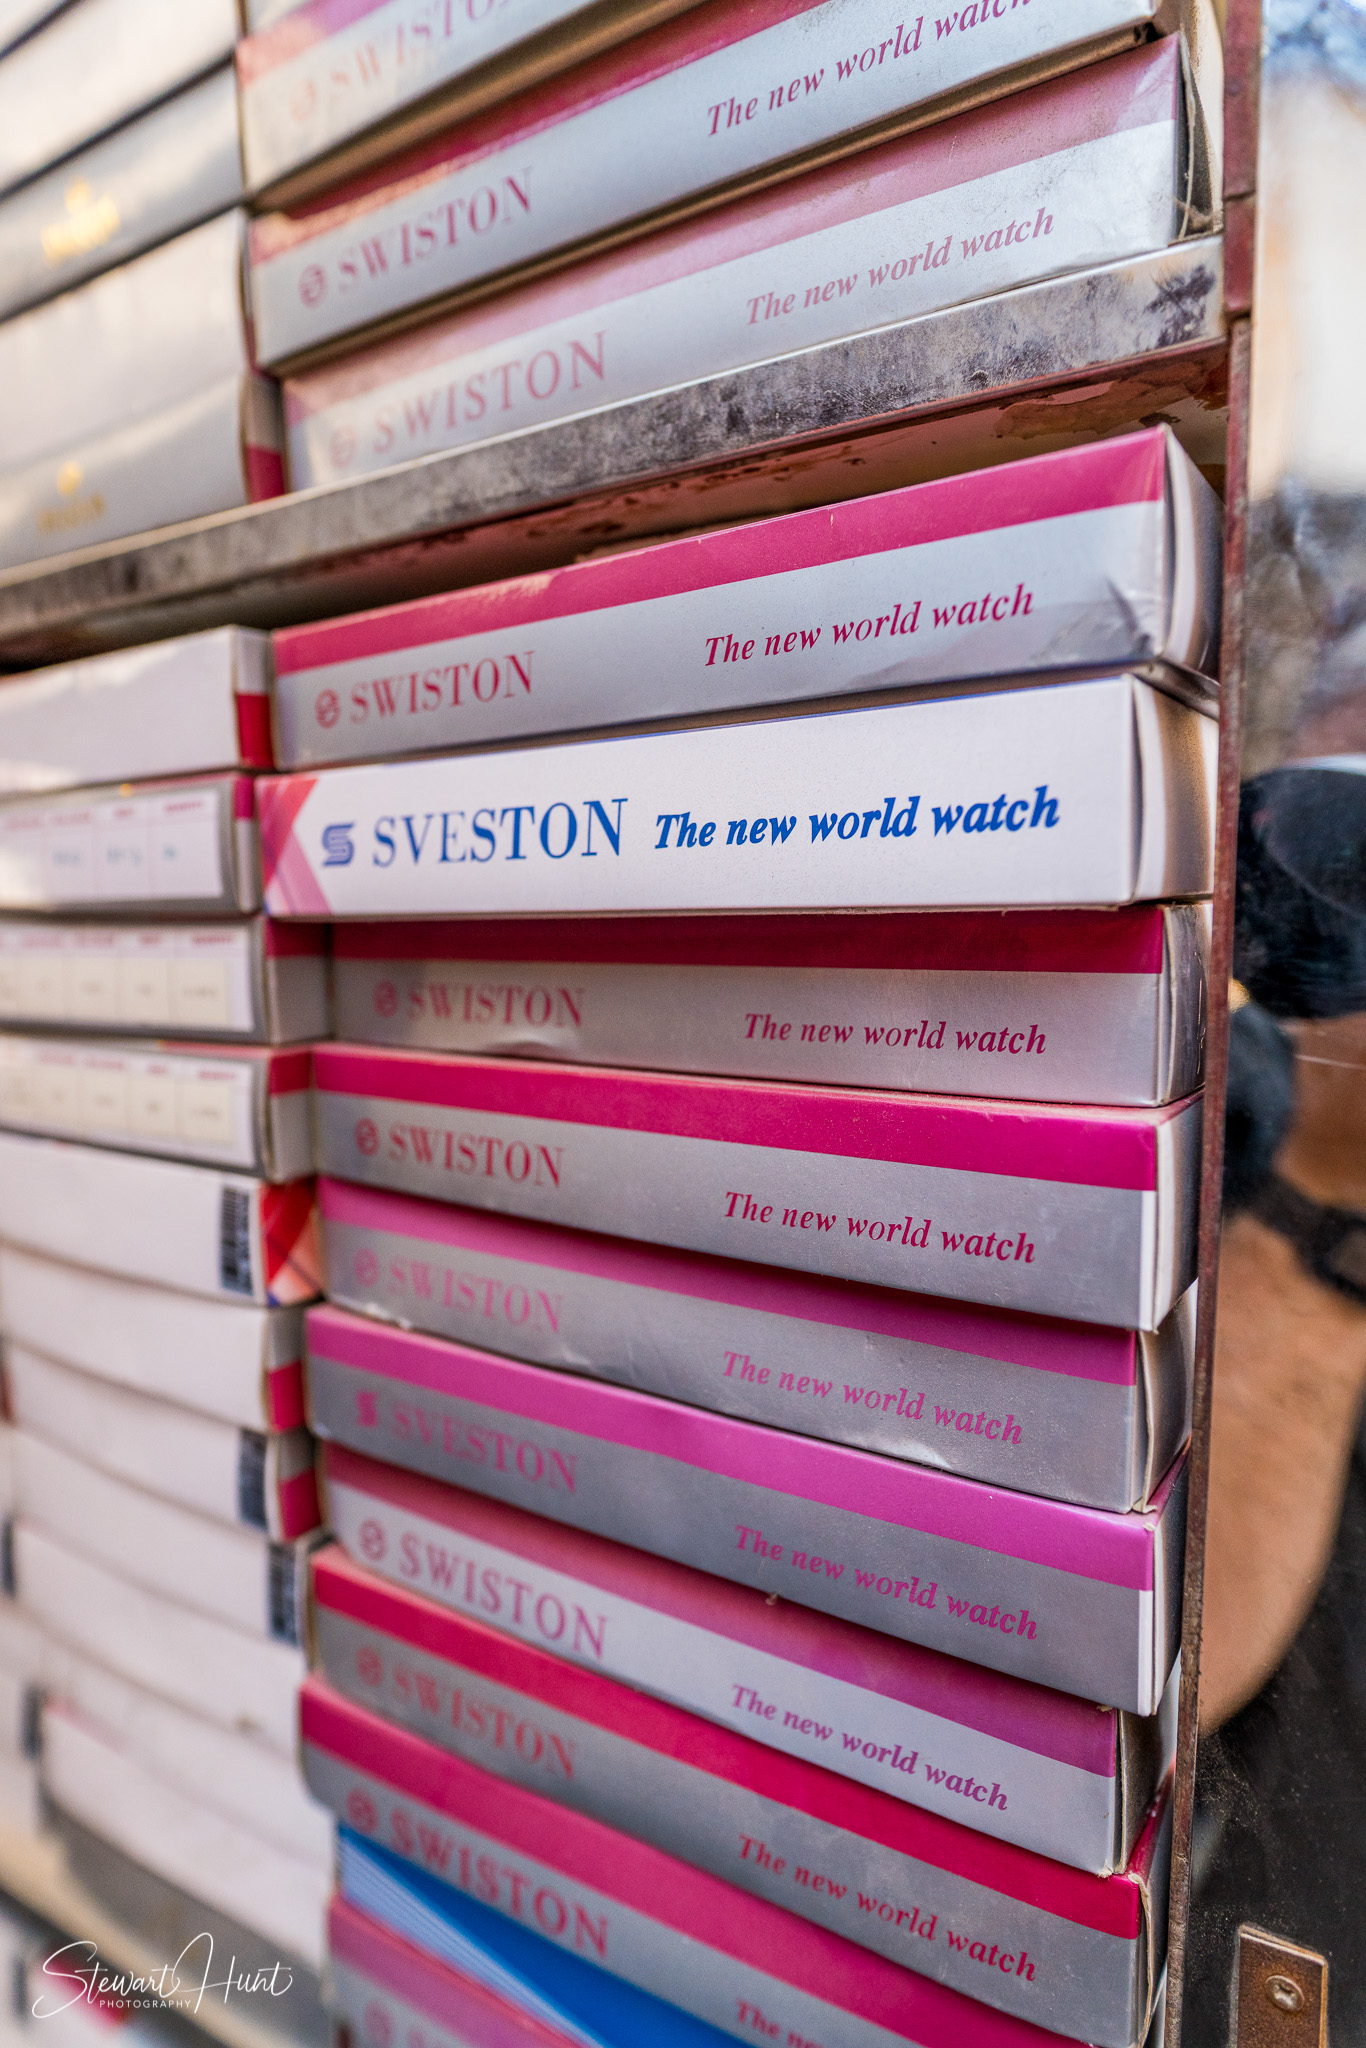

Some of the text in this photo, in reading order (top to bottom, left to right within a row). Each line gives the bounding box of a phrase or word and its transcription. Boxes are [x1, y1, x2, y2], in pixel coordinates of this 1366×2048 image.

[337, 167, 533, 292] SWISTON
[707, 97, 759, 136] The
[768, 68, 825, 111] new
[836, 17, 924, 81] world
[372, 208, 1053, 453] SWISTON The new world watch
[350, 582, 1033, 722] SWISTON The new world watch
[373, 784, 1060, 867] SVESTON The new world watch
[409, 982, 1046, 1055] SWISTON The new world watch
[389, 1124, 1035, 1264] SWISTON The new world watch
[390, 1255, 1022, 1445] SWISTON The new world watch
[393, 1402, 1038, 1641] SVESTON The new world watch
[398, 1534, 1008, 1811] SWISTON The new world watch
[390, 1810, 781, 2039] SWISTON The
[394, 1667, 1036, 1982] SWISTON The new world watch
